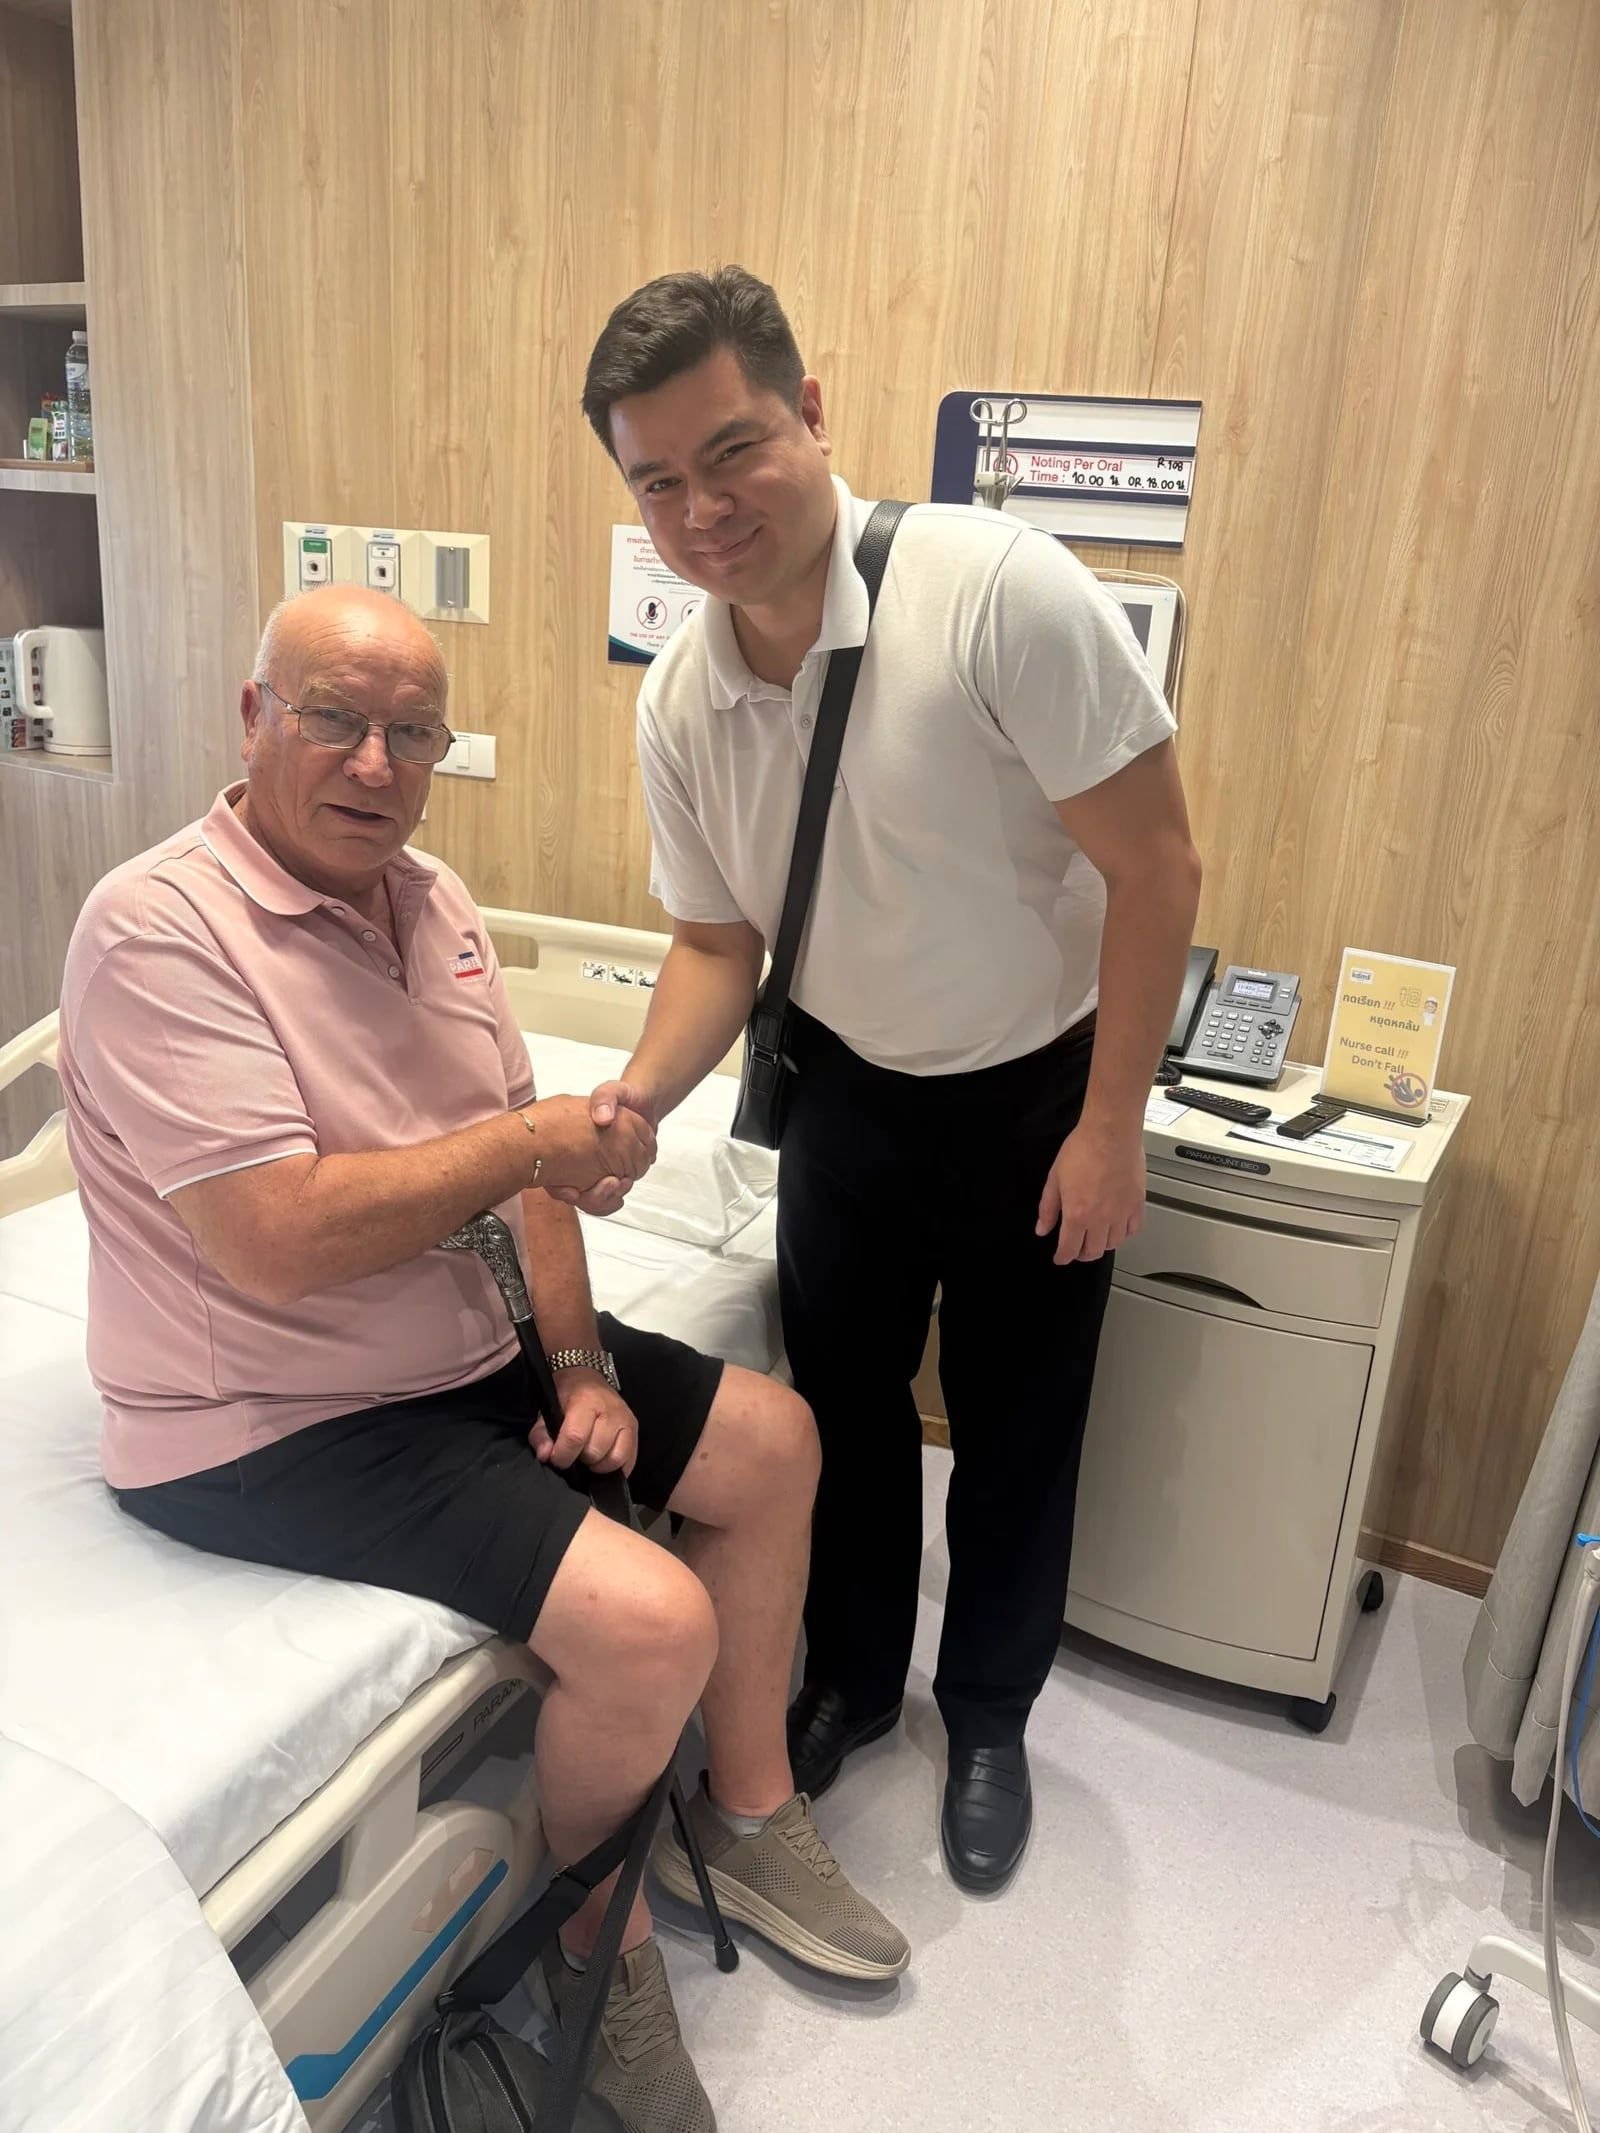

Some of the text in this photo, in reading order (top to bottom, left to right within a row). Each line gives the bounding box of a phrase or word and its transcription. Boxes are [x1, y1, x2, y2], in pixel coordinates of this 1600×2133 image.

[1031, 456, 1123, 472] Noting Per Oral
[1030, 470, 1059, 482] Time
[1342, 992, 1381, 1009] กดเรียก
[1340, 1036, 1372, 1051] Nurse
[1375, 1044, 1395, 1057] call
[1384, 1062, 1404, 1075] Fall
[1185, 1149, 1239, 1167] PARAMOUNT
